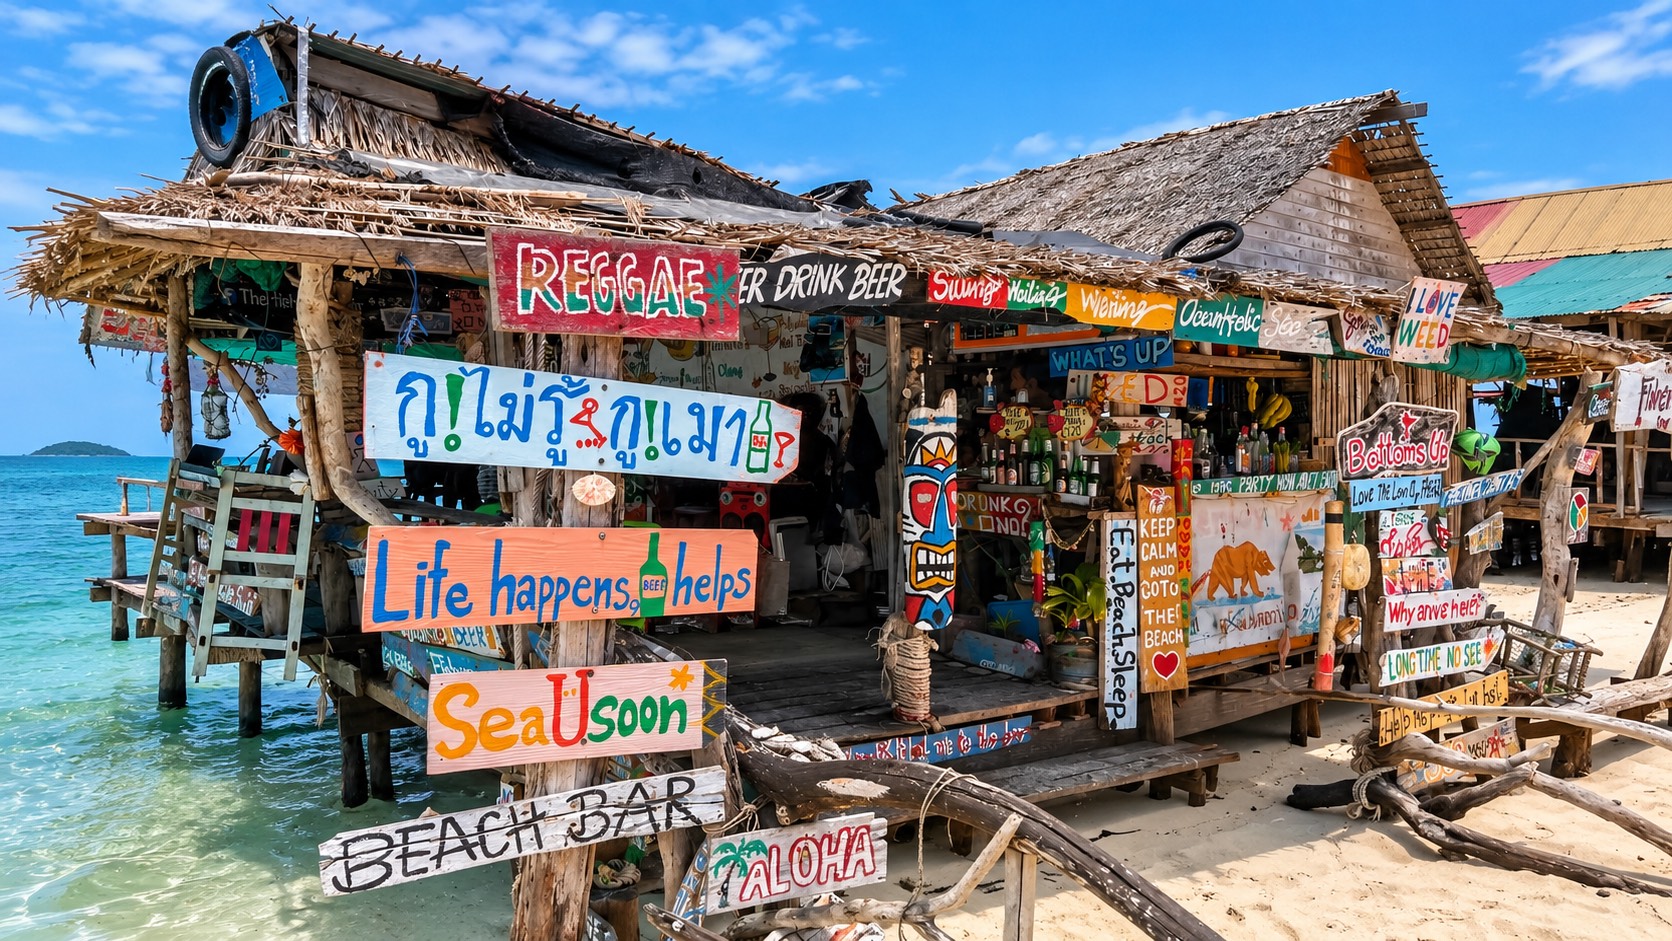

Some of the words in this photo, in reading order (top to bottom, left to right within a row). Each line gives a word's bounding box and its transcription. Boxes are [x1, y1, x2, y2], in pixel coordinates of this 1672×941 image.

[516, 243, 707, 319] REGGAE
[774, 262, 847, 302] DRINK
[848, 261, 908, 301] BEER
[1405, 287, 1416, 314] I
[1416, 287, 1458, 318] LOVE
[1399, 319, 1449, 349] WEED
[1136, 338, 1172, 365] UP
[1346, 431, 1427, 475] Bottoms
[1139, 516, 1175, 539] KEEP
[1141, 542, 1177, 562] CALM
[372, 538, 473, 623] Life
[672, 541, 751, 611] helps
[1388, 600, 1416, 626] Why
[1145, 628, 1184, 649] BEACH
[1447, 645, 1461, 668] NO
[332, 800, 546, 893] BEACH
[564, 776, 702, 848] BAR
[739, 824, 876, 902] ALOHA
